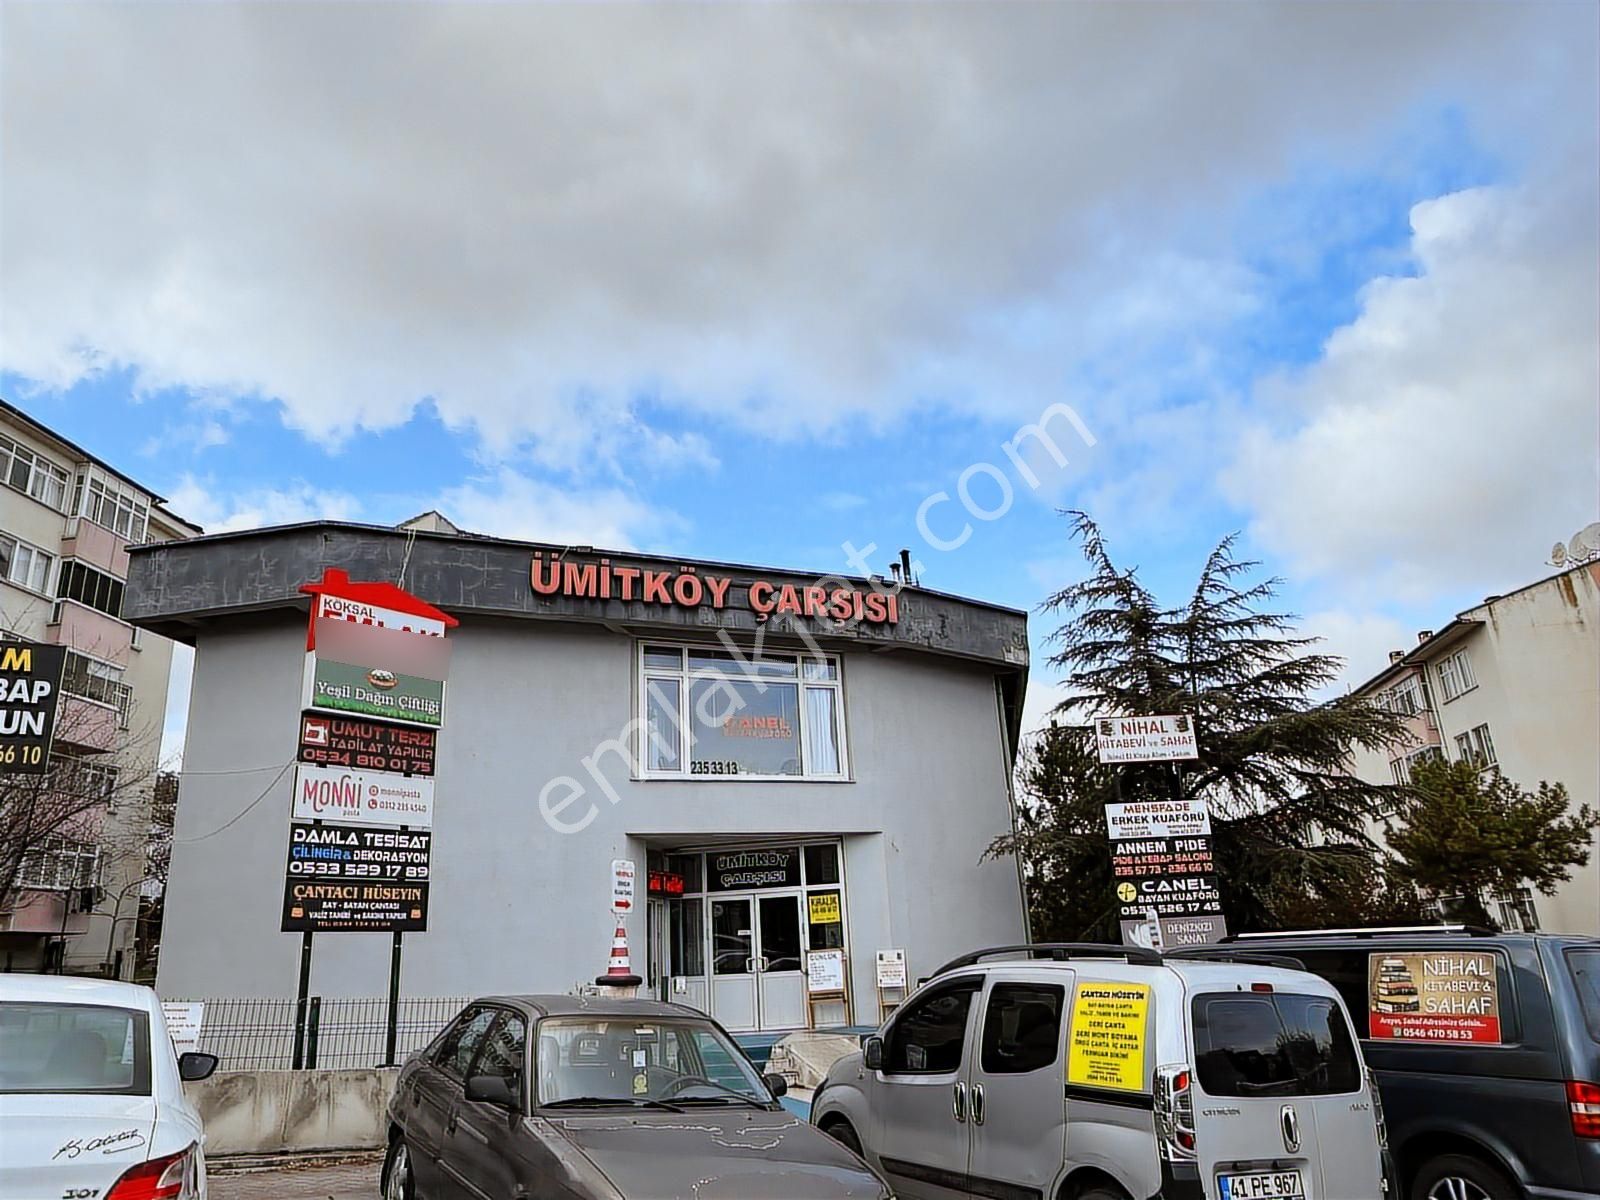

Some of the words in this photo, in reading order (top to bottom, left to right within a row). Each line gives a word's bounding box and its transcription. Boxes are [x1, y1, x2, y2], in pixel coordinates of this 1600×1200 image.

[531, 552, 732, 609] ÜMİTKÖY
[749, 581, 899, 626] ÇARŞISI
[0, 648, 31, 671] M
[317, 682, 350, 699] Yeşil
[356, 688, 393, 706] Dağın
[399, 695, 440, 714] Çiftliği
[332, 720, 384, 740] UMUT
[1121, 719, 1168, 735] NİHAL
[331, 738, 384, 753] TADİLAT
[387, 744, 433, 759] YAPILIR
[1099, 736, 1146, 749] KİTABEVİ
[1161, 735, 1194, 746] SAHAF
[23, 746, 41, 764] 10
[303, 749, 350, 765] 0534
[357, 755, 385, 767] 810
[390, 759, 406, 769] 01
[412, 761, 431, 772] 75
[690, 761, 709, 774] 235
[711, 761, 723, 774] 33
[726, 762, 738, 774] 13
[1112, 815, 1149, 825] ERKEK
[1152, 812, 1205, 824] KUAFÖRÜ
[294, 829, 359, 845] DAMLA
[364, 832, 429, 848] TESİSAT
[292, 844, 341, 859] ÇİLİNGİR
[354, 850, 427, 863] DEKORASYON
[1116, 841, 1166, 854] ANNEM
[717, 850, 789, 870] ÜMİTKÖY
[1142, 855, 1172, 863] KEBAP
[1175, 852, 1212, 862] SALONU
[290, 861, 340, 875] 0533
[345, 864, 380, 876] 529
[386, 865, 401, 876] 17
[405, 867, 428, 877] 89
[1115, 867, 1133, 876] 235
[1135, 866, 1147, 875] 57
[1149, 865, 1160, 874] 73
[1168, 864, 1187, 873] 236
[1189, 863, 1201, 872] 66
[1203, 863, 1213, 871] 10
[721, 871, 786, 887] ÇARŞISI
[1142, 879, 1211, 892] CANEL
[293, 885, 358, 901] ÇANTACI
[1138, 894, 1170, 903] BAYAN
[1172, 890, 1219, 901] KUAFÖRÜ
[1158, 904, 1184, 913] 526
[1187, 903, 1199, 911] 17
[1203, 902, 1220, 911] 45
[1177, 934, 1207, 944] SANAT
[1423, 956, 1490, 976] NİHAL
[1483, 982, 1491, 992] &
[1425, 997, 1492, 1014] SAHAF
[1403, 1028, 1425, 1037] 0546
[1427, 1029, 1445, 1038] 470
[1447, 1029, 1458, 1038] 58
[1460, 1030, 1472, 1039] 53
[1231, 1177, 1247, 1197] 41
[1252, 1176, 1270, 1196] PE
[1274, 1174, 1297, 1195] 967
